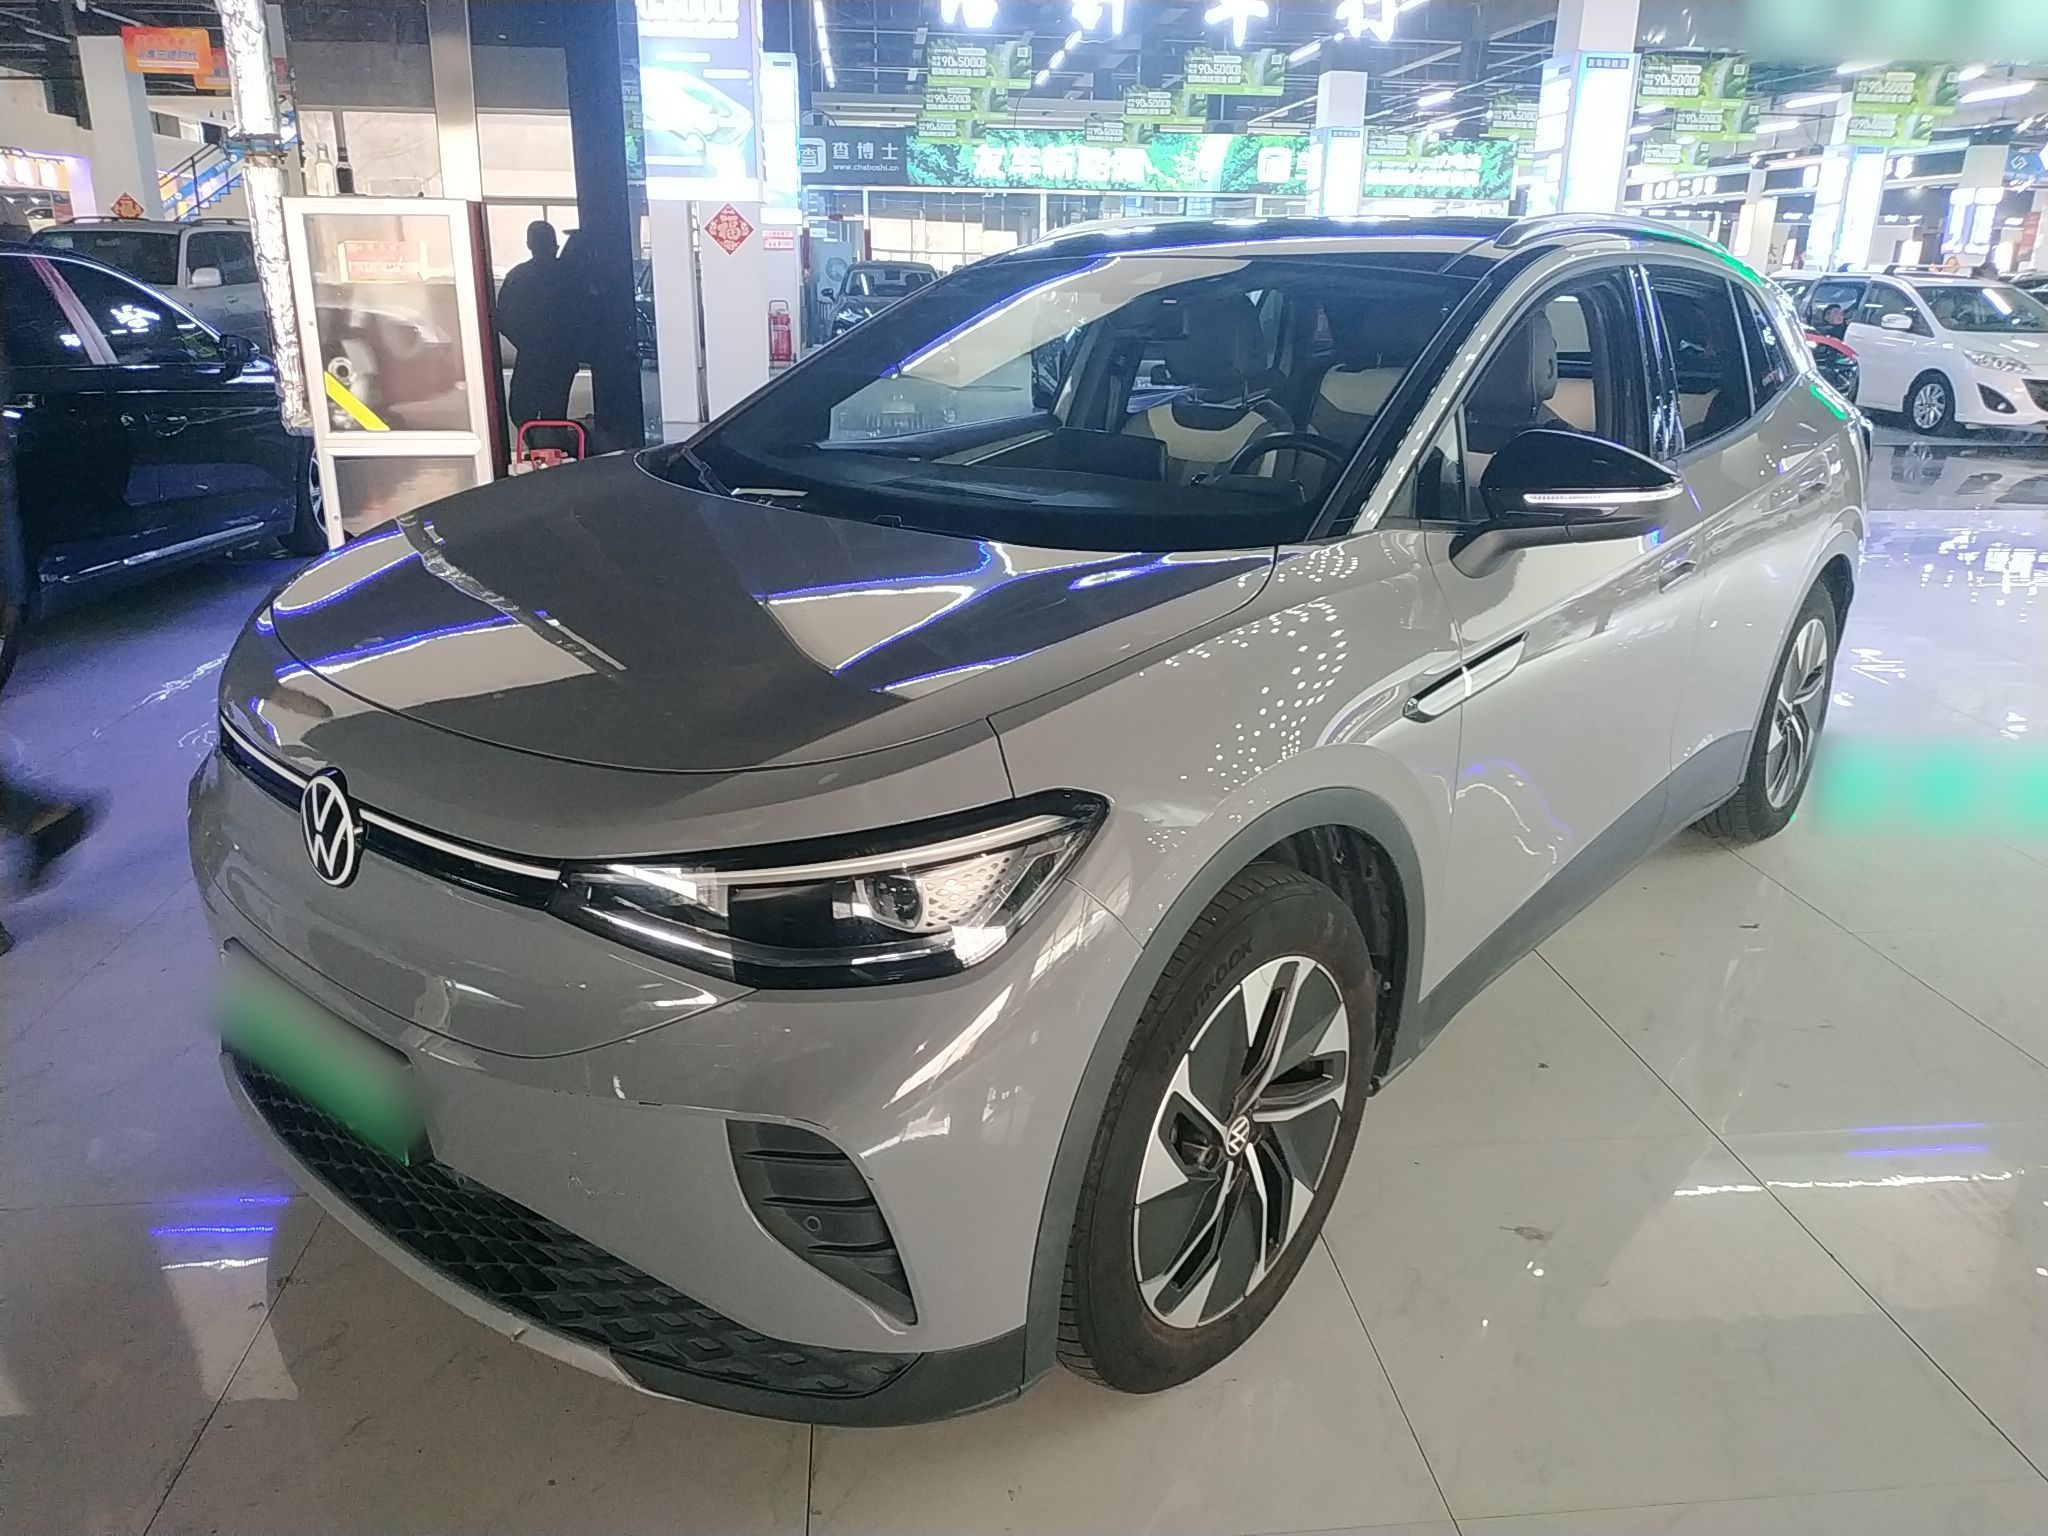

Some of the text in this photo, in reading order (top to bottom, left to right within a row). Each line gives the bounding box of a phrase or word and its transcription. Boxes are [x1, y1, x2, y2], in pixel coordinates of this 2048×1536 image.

[832, 142, 899, 160] 查博士
[832, 164, 899, 172] www.chaboshi.cn
